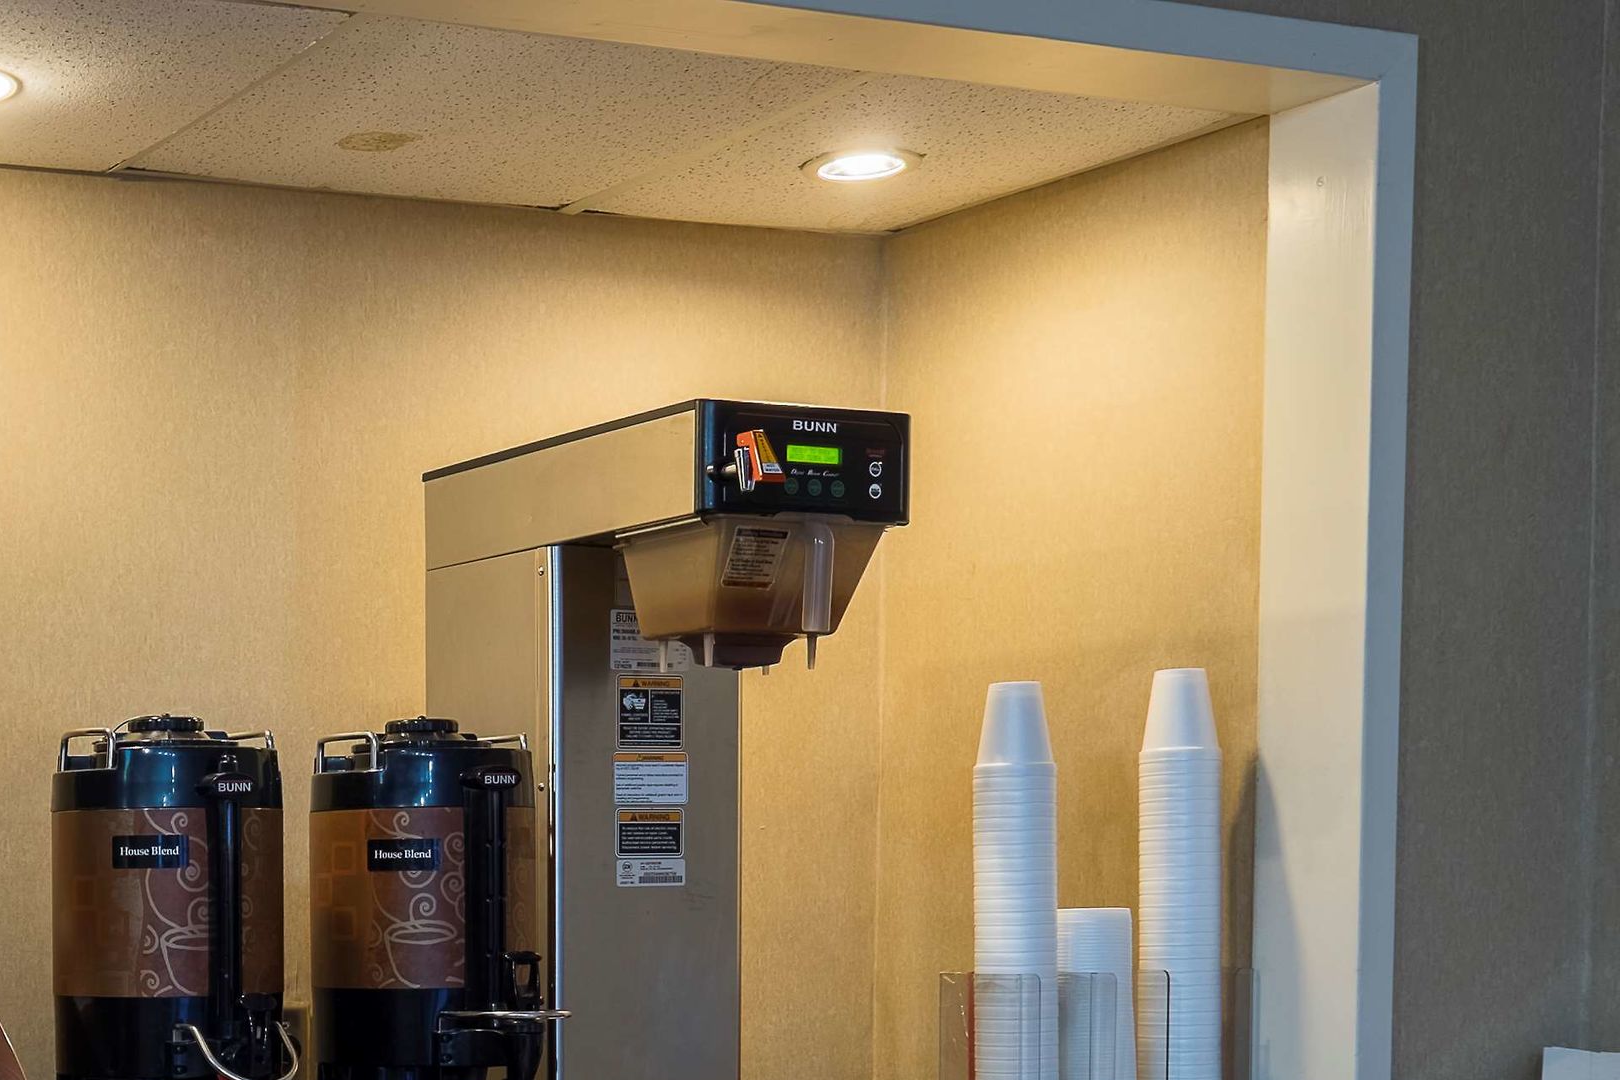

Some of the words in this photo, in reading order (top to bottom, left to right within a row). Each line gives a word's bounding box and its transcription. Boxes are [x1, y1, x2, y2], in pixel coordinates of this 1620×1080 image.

[792, 420, 837, 433] BUNN
[484, 775, 516, 784] BUNN
[217, 782, 251, 792] BUNN
[638, 813, 670, 821] WARNING
[120, 846, 149, 856] House
[151, 845, 180, 856] Blend
[374, 849, 403, 859] House
[404, 849, 432, 859] Blend
